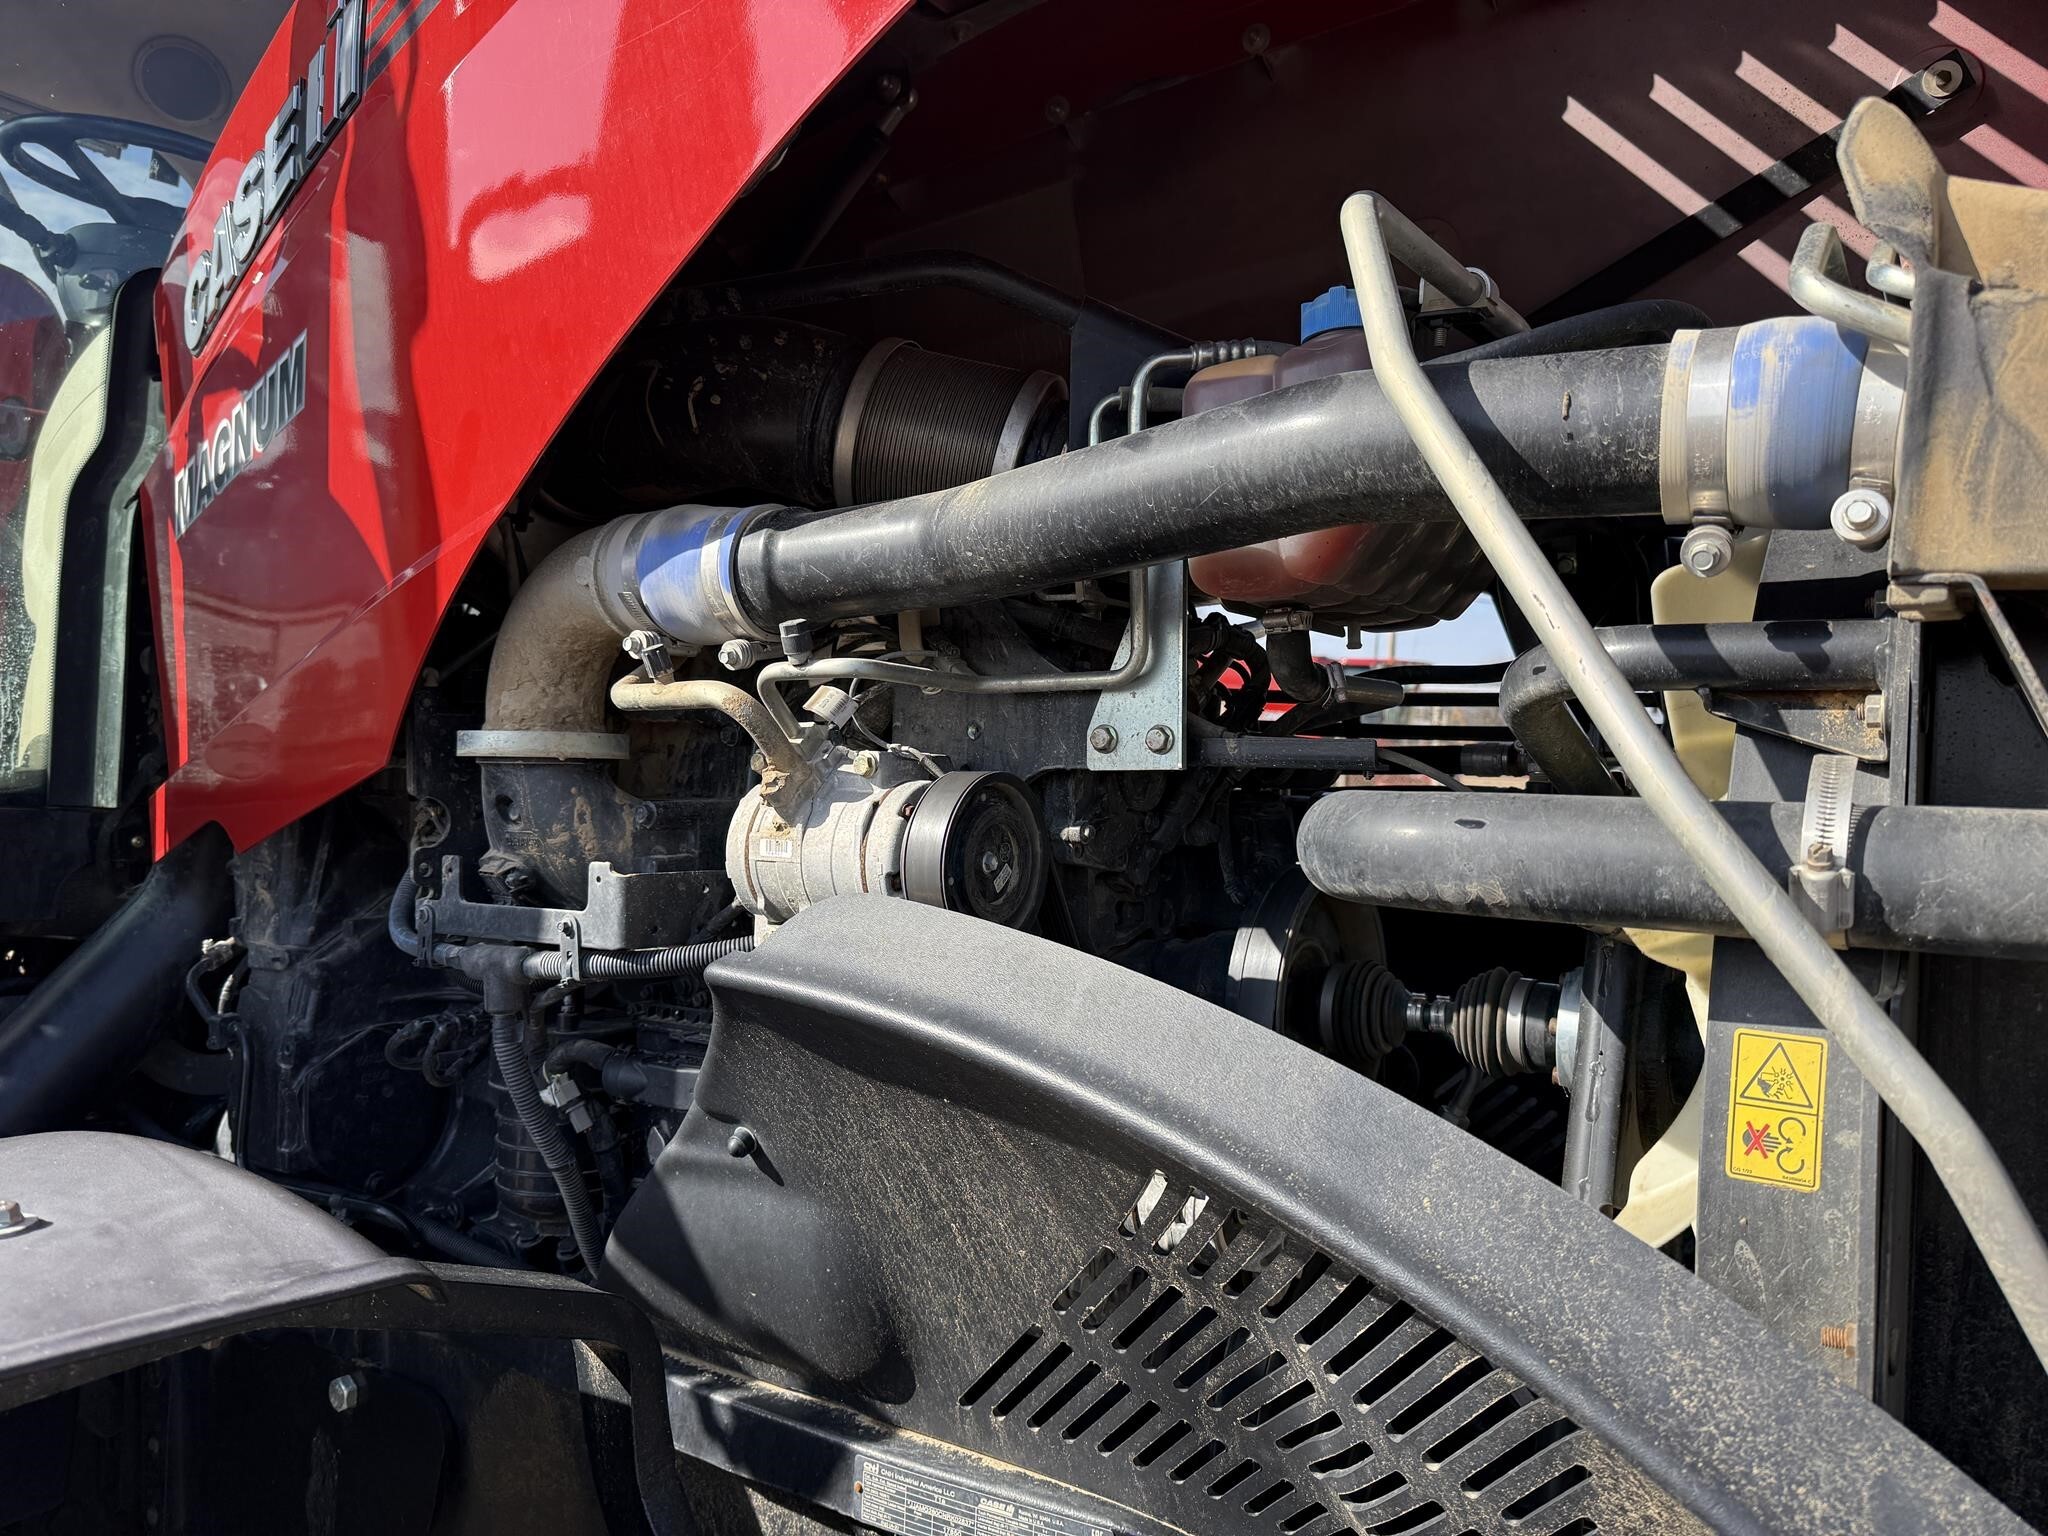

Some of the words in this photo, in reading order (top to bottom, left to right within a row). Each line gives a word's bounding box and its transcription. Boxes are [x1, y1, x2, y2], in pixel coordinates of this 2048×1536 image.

[184, 80, 303, 356] CASE
[174, 328, 308, 540] MAGNUM
[895, 1472, 919, 1487] Industrial
[919, 1480, 942, 1494] America
[942, 1487, 956, 1498] LLC
